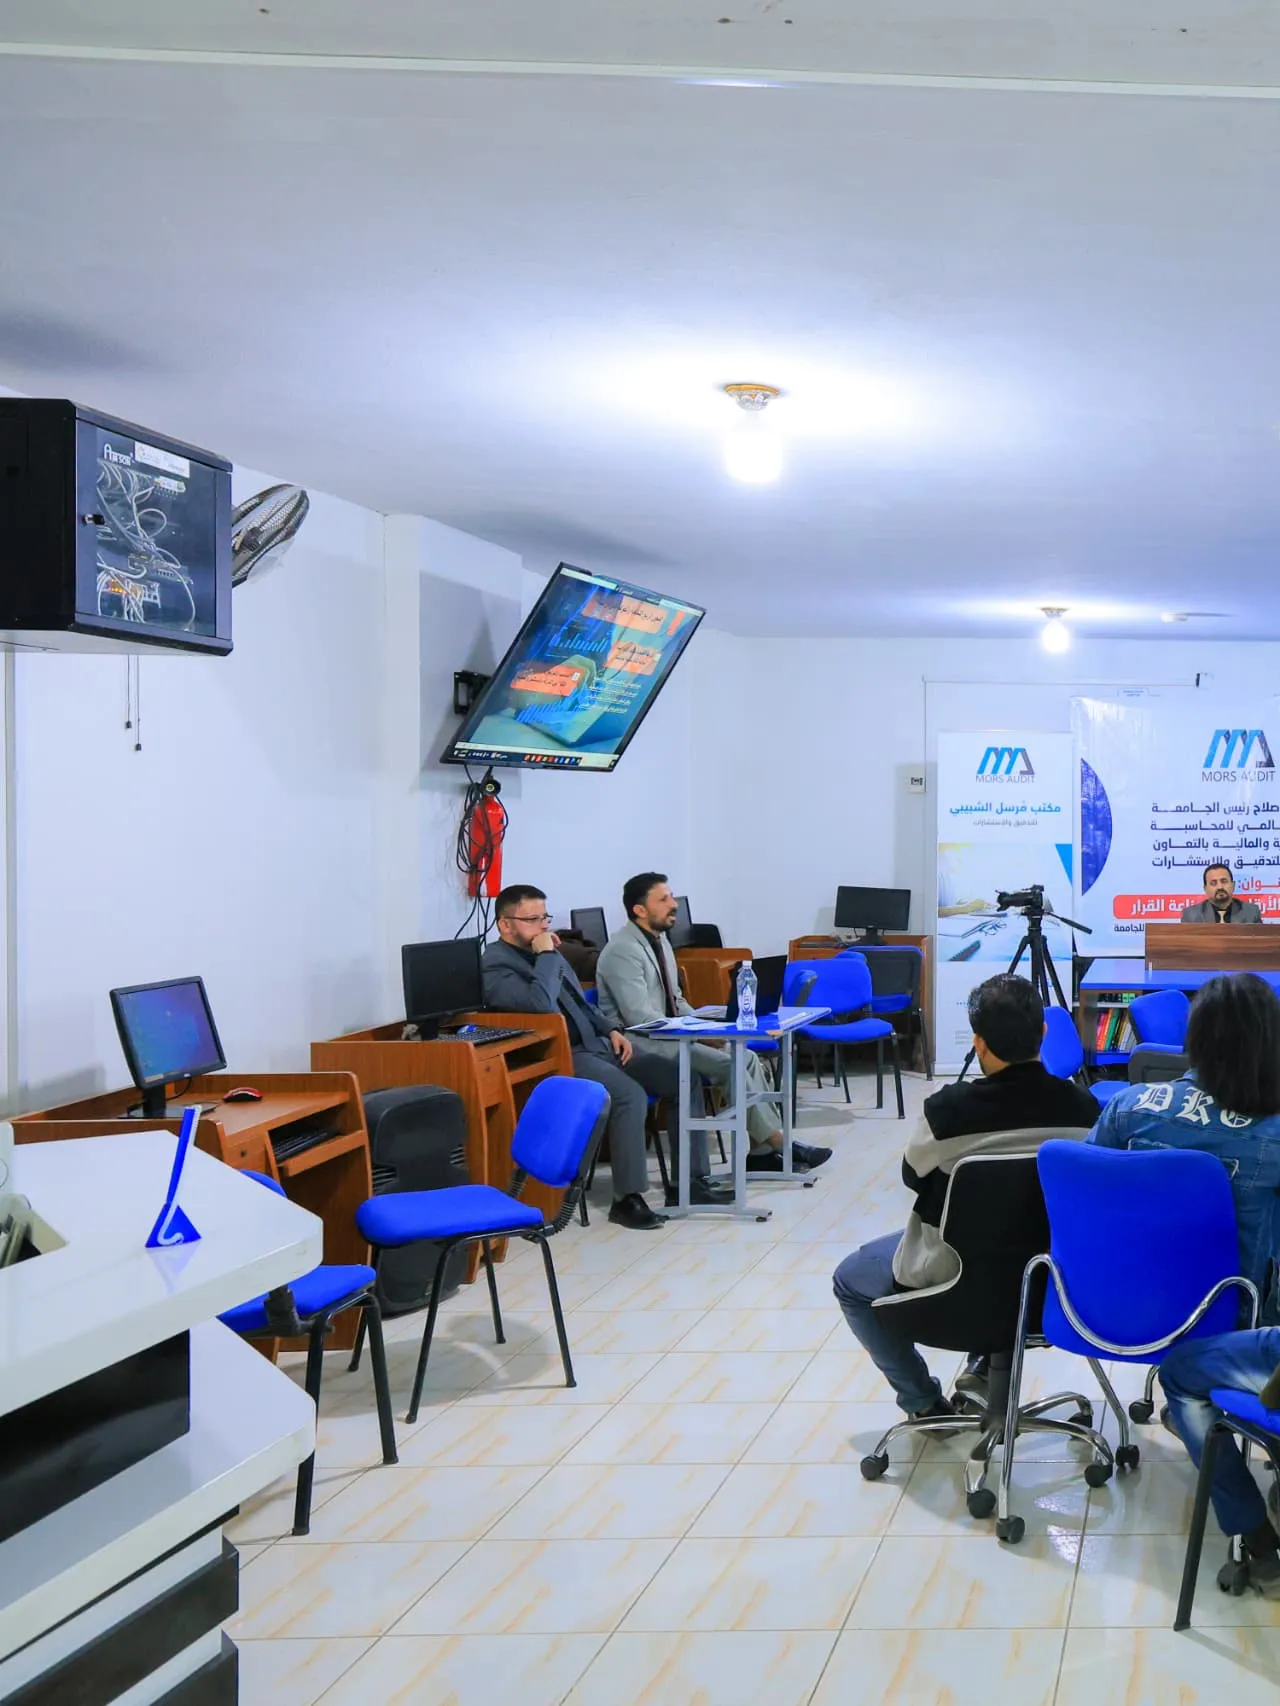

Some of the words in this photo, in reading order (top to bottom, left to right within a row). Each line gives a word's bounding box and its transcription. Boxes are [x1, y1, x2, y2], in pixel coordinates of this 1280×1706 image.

[976, 775, 1004, 784] MORS
[1006, 775, 1035, 784] AUDIT
[1202, 771, 1237, 782] MORS
[1030, 802, 1061, 816] مكتب
[1152, 801, 1219, 814] الجامعة
[1223, 802, 1250, 815] رئيس
[1253, 801, 1279, 816] صلاح
[1150, 820, 1233, 833] للمحاسبة
[1152, 837, 1209, 851] بالتعاون
[1212, 837, 1269, 851] والمالية
[1131, 899, 1165, 915] القرار
